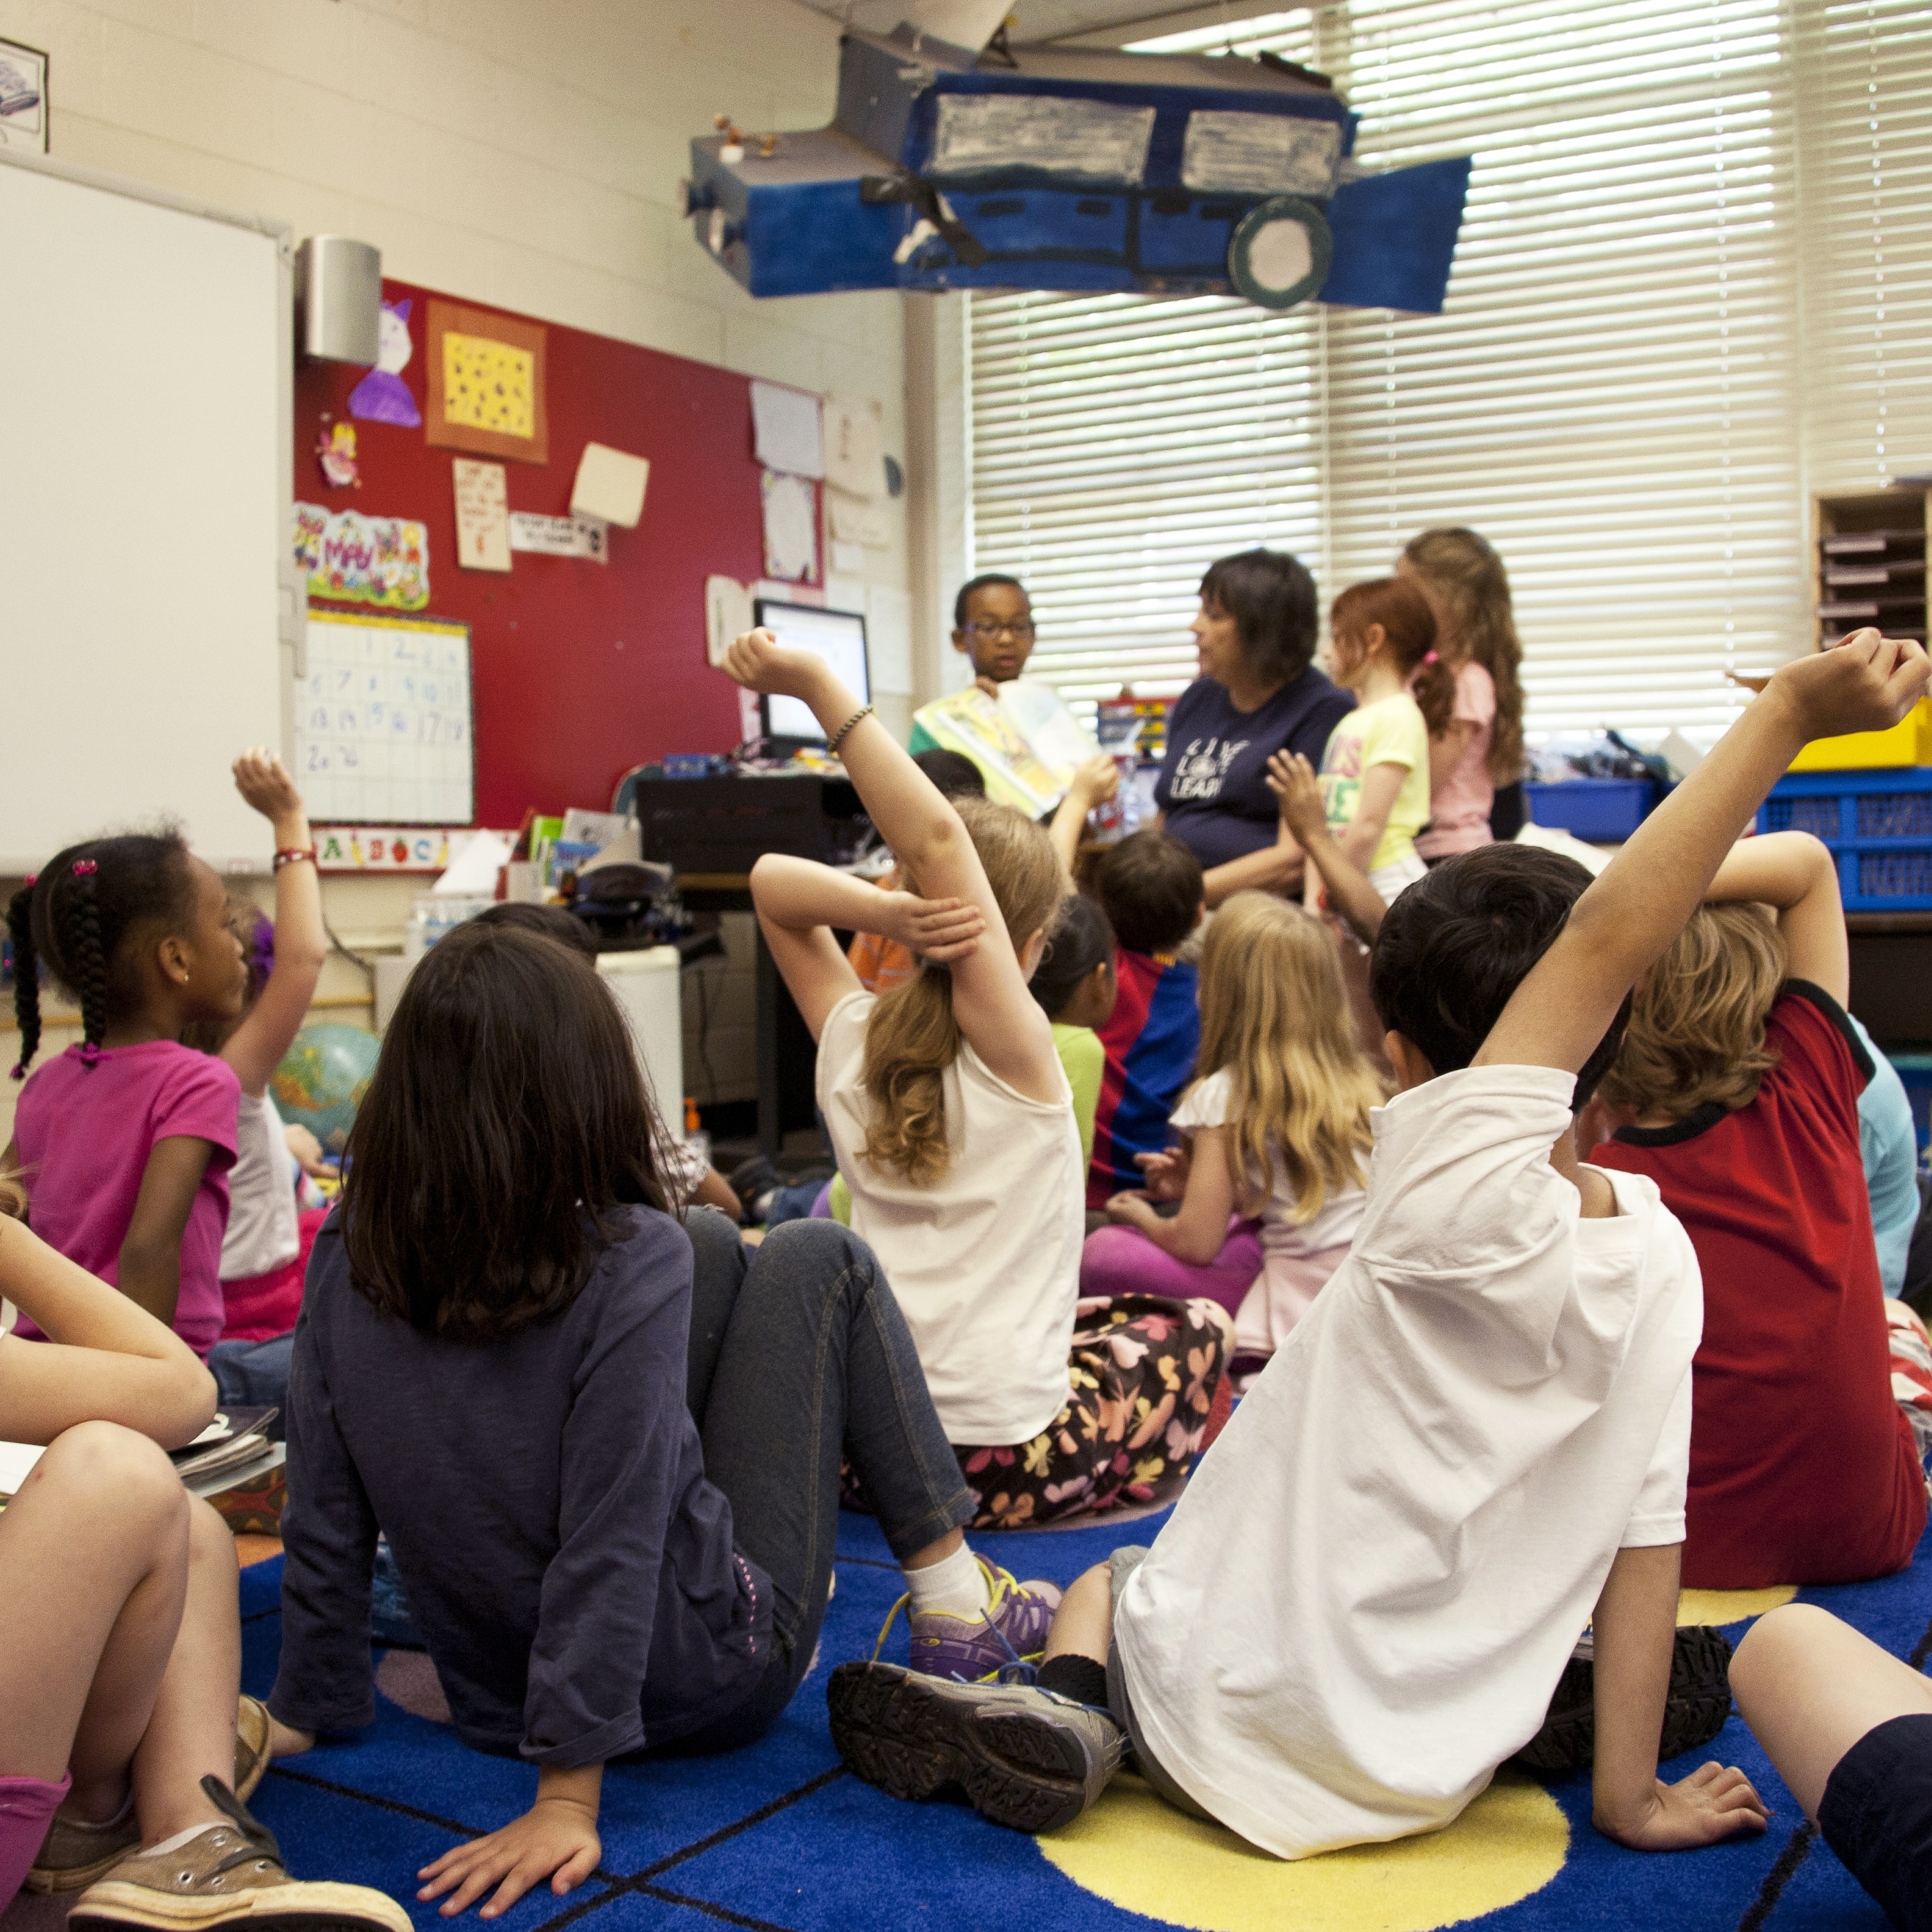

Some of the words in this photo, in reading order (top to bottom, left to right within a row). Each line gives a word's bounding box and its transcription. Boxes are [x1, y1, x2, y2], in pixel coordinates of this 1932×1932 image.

[393, 635, 417, 660] 2
[337, 668, 353, 690] 7
[417, 710, 443, 746] 17
[323, 836, 342, 860] A
[369, 839, 386, 861] B
[414, 838, 431, 861] C
